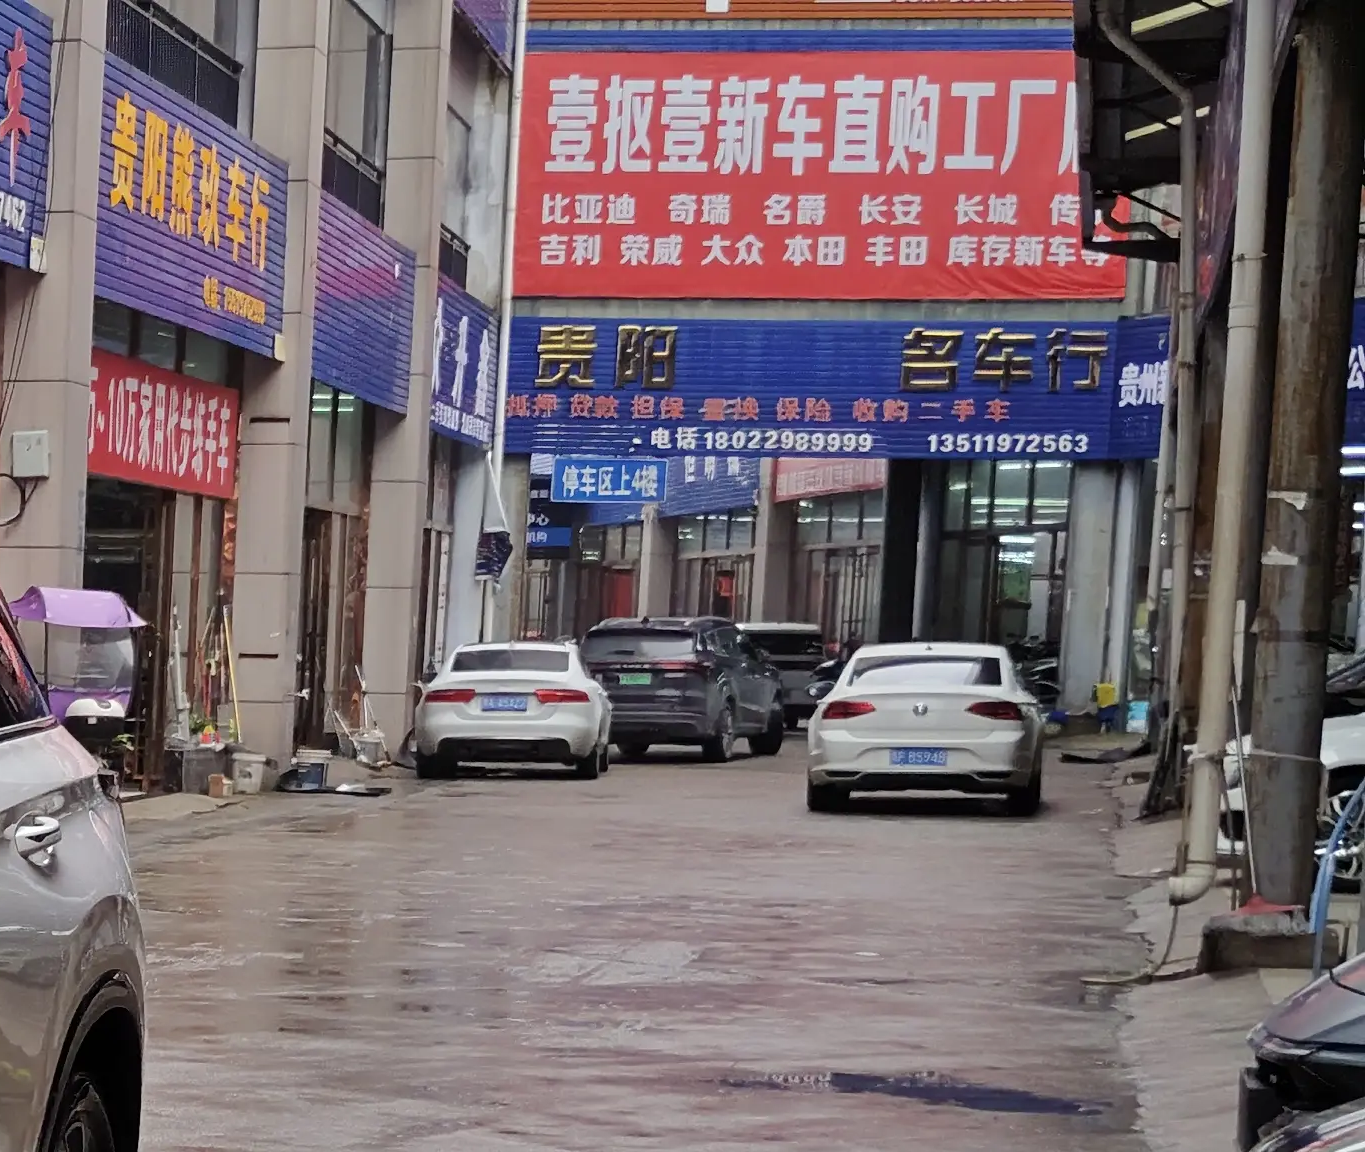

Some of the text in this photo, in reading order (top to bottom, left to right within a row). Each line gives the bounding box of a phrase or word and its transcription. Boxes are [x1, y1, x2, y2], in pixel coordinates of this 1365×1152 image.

[541, 193, 636, 225] 比亚迪
[668, 194, 731, 225] 奇瑞
[763, 194, 827, 225] 名爵
[859, 194, 922, 226] 长安
[954, 194, 1018, 226] 长城
[539, 234, 601, 266] 吉利
[619, 234, 683, 266] 荣威
[701, 234, 764, 266] 大众
[782, 234, 846, 267] 本田
[865, 235, 929, 267] 丰田
[534, 325, 680, 391] 贵阳
[900, 327, 1110, 393] 名车行
[631, 395, 685, 420] 担保
[776, 398, 831, 422] 保险
[927, 433, 1089, 454] 13511972563
